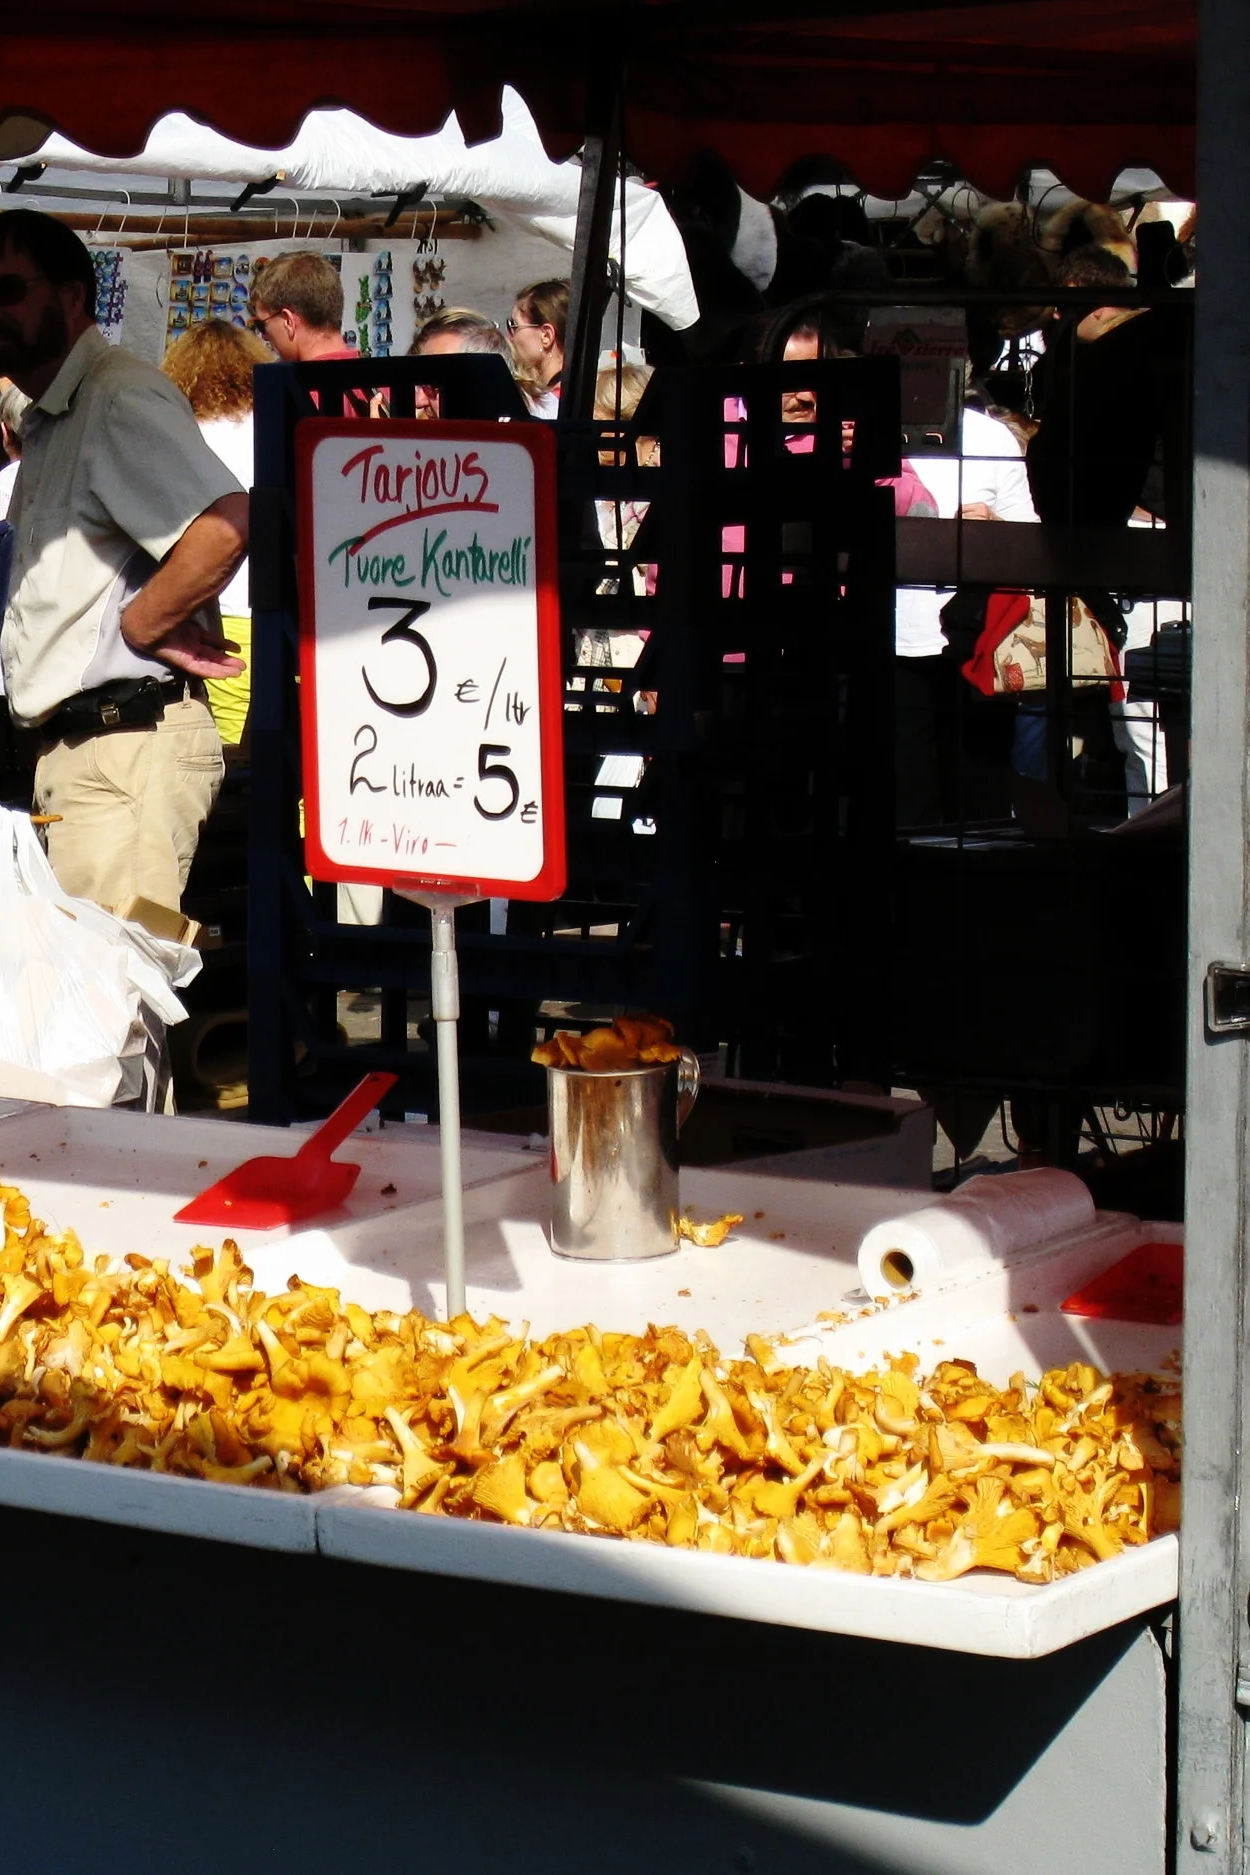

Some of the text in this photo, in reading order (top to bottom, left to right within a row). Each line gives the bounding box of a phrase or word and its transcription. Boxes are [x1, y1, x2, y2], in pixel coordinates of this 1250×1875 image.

[340, 444, 489, 511] Tarjous
[421, 527, 532, 597] Kantarelli
[361, 596, 438, 719] 3
[350, 723, 388, 796] 2
